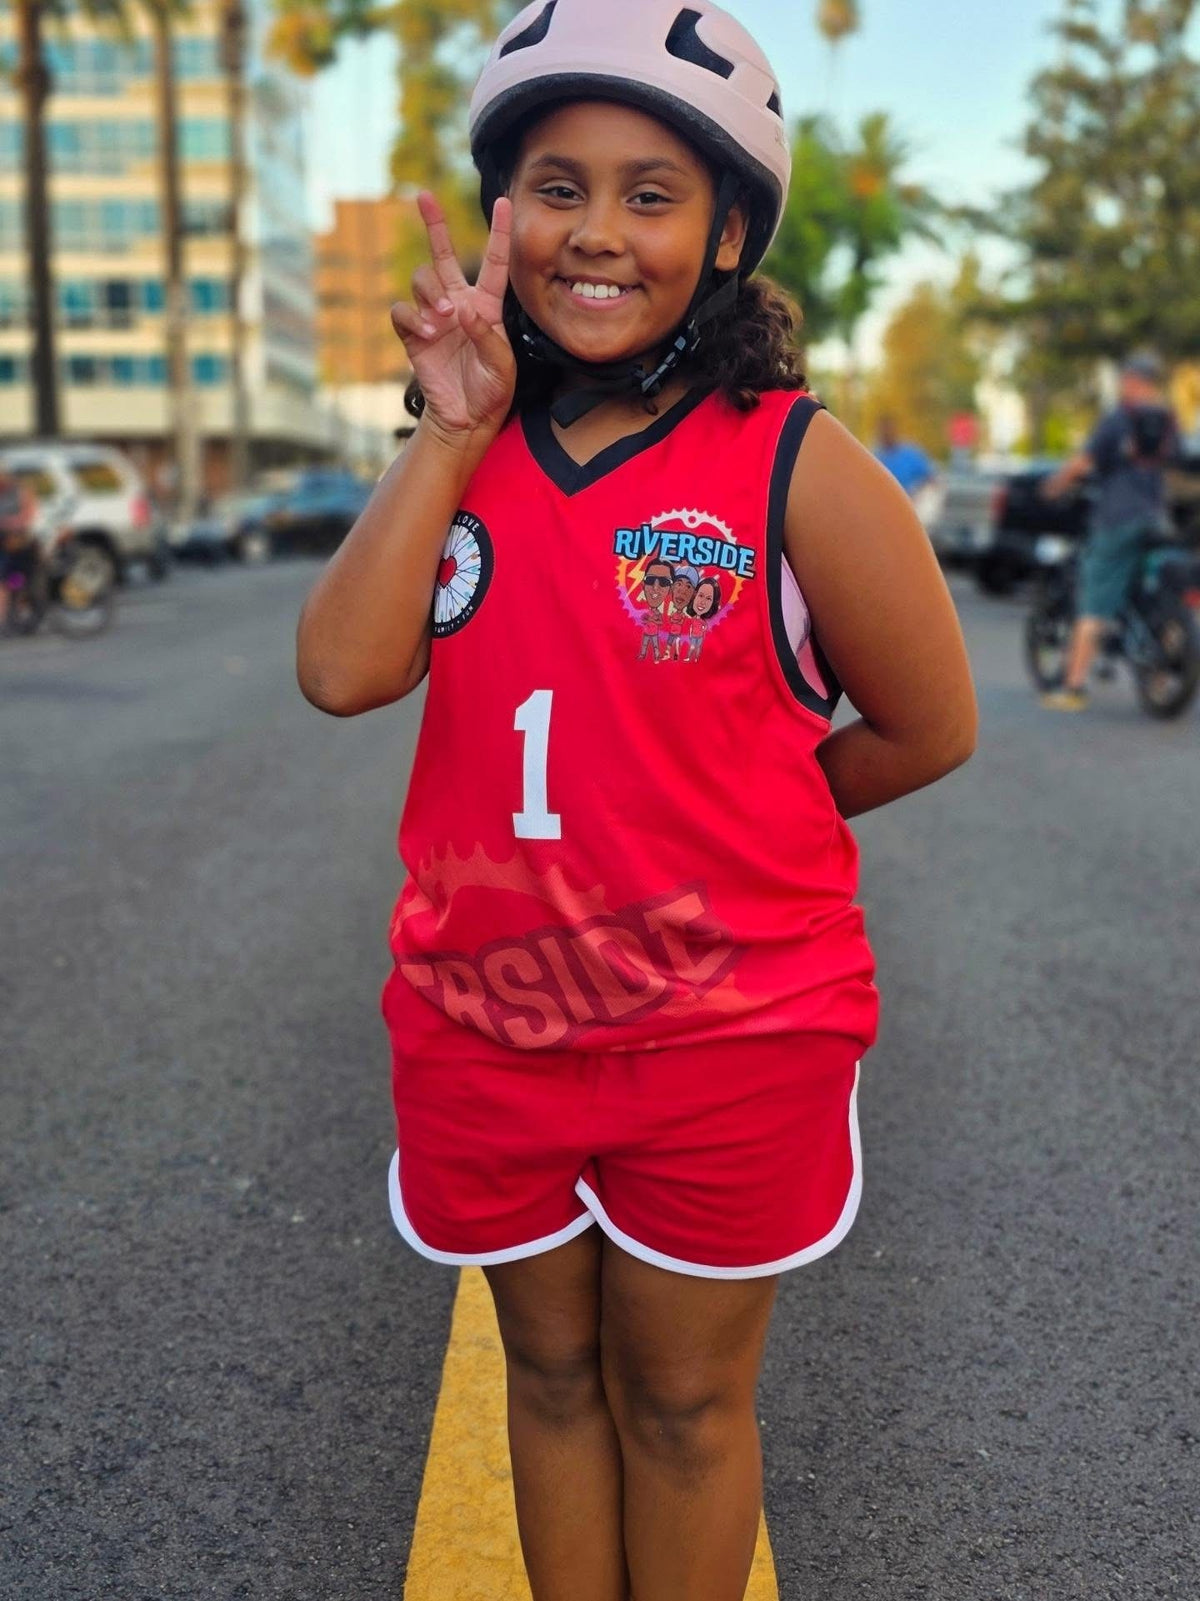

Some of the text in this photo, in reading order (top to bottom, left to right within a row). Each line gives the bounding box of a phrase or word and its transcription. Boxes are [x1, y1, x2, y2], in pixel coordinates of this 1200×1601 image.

[457, 515, 480, 532] LOVE
[614, 525, 756, 579] RIVERSIDE
[512, 689, 562, 840] 1
